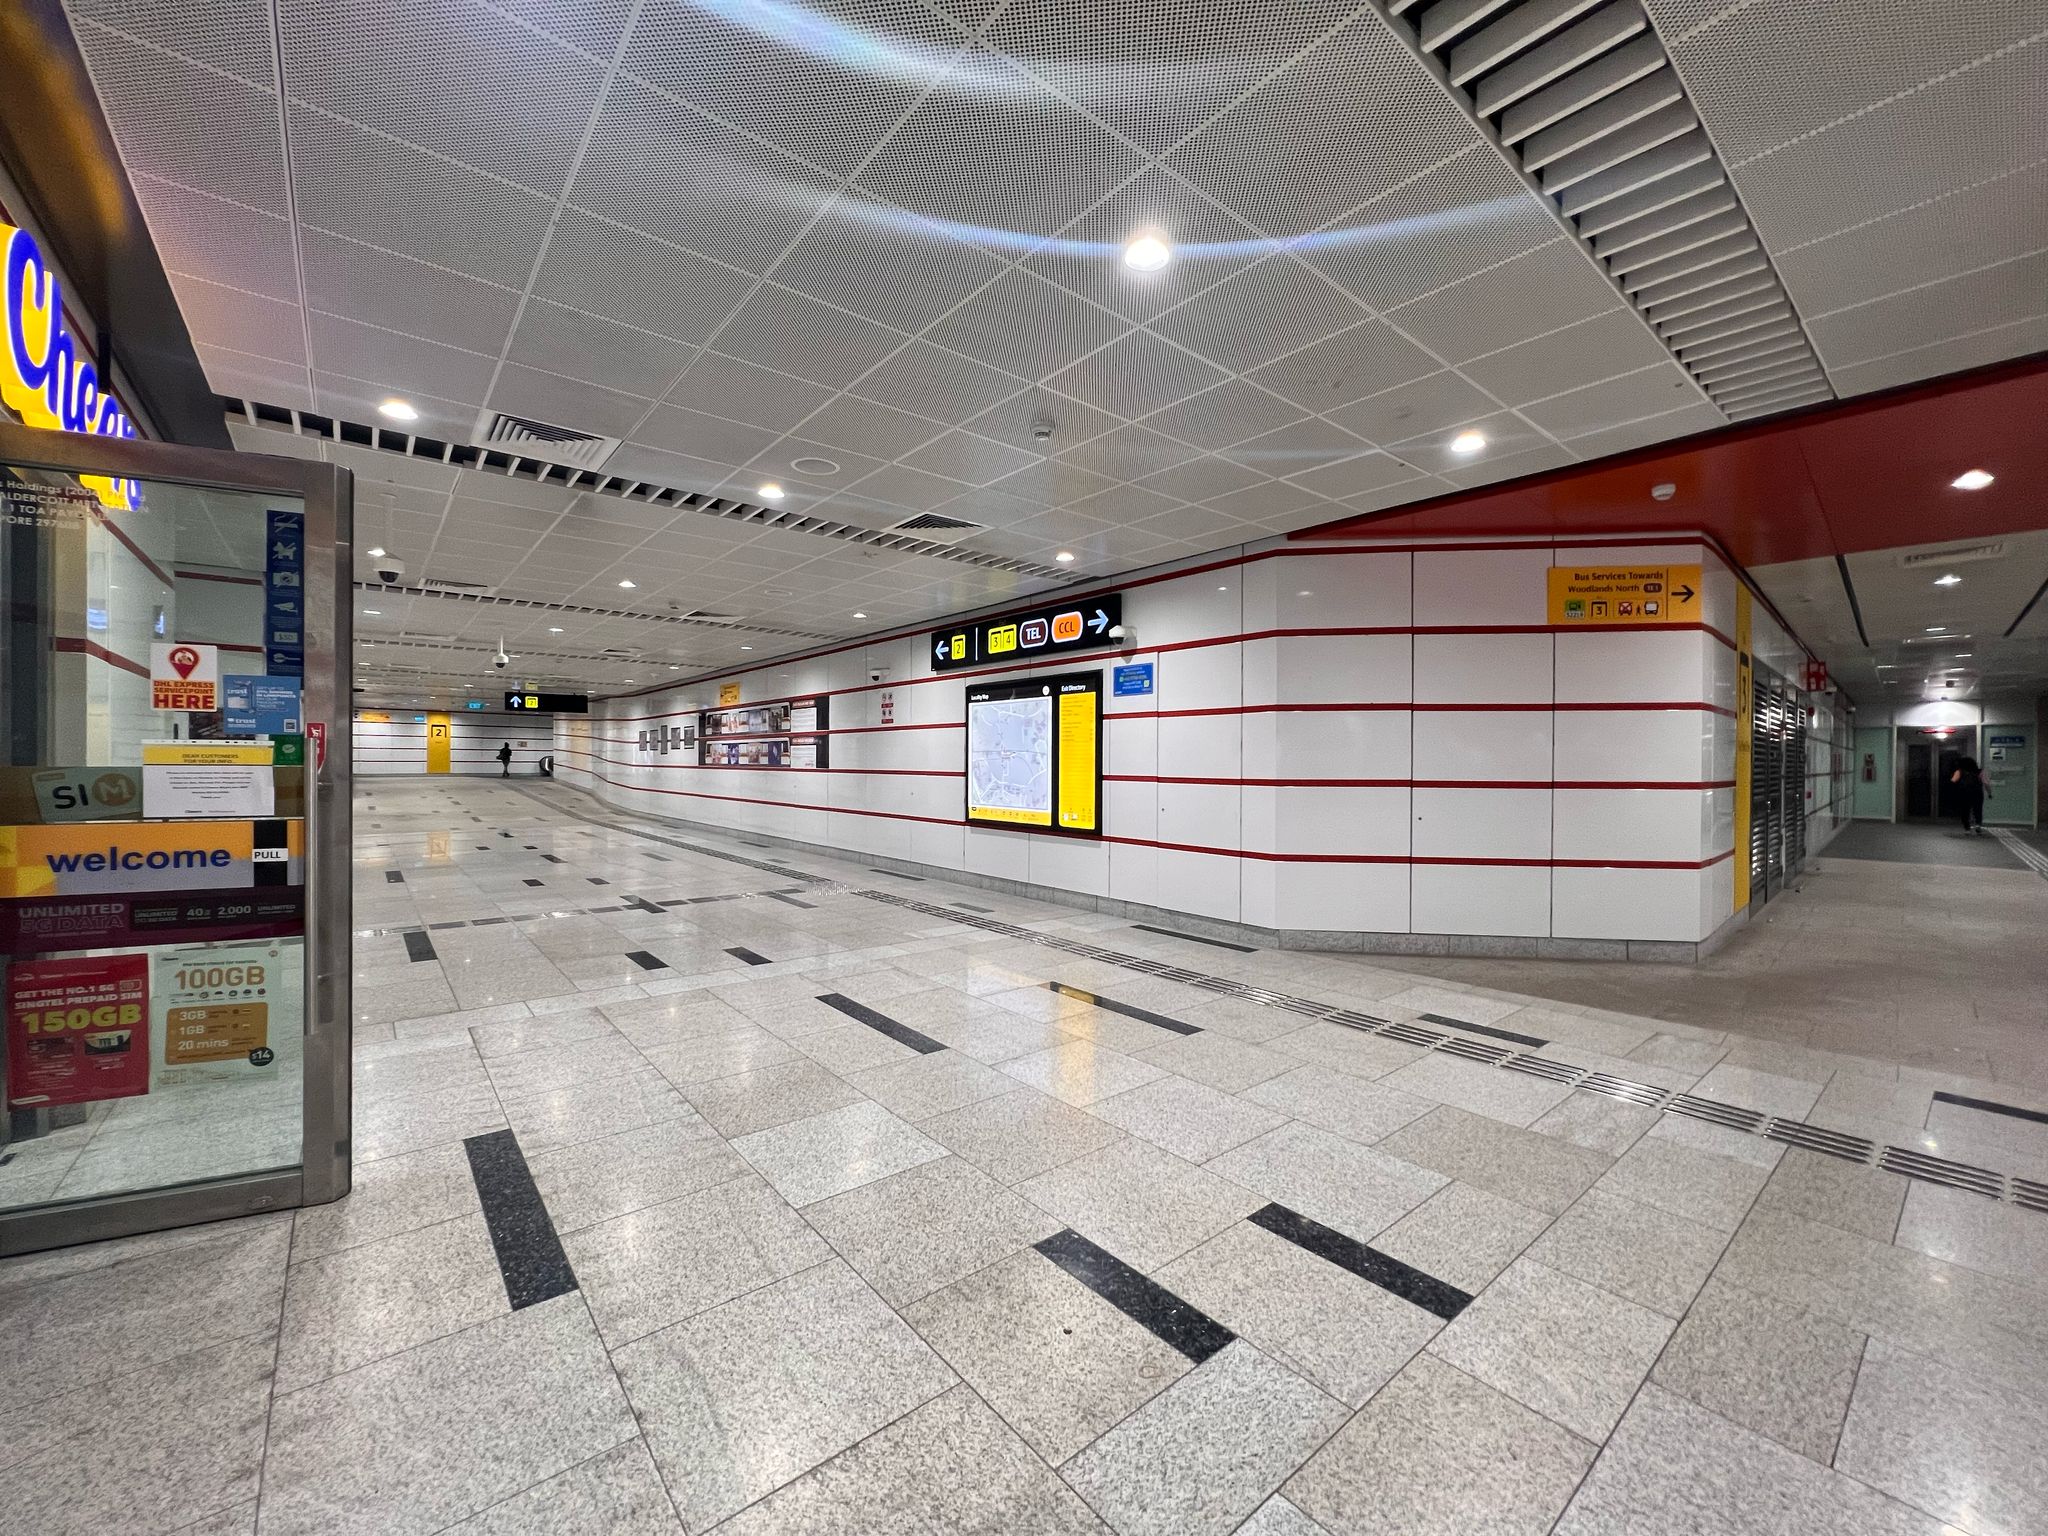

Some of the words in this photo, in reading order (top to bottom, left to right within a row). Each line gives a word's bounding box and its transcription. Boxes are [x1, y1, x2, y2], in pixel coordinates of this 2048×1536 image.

[7, 480, 61, 495] Holdings
[20, 505, 46, 515] TOA
[1574, 573, 1589, 581] Bus
[1592, 572, 1626, 580] Services
[1629, 571, 1663, 580] Towards
[1568, 585, 1613, 593] Woodlands
[1616, 584, 1640, 592] North
[1596, 606, 1603, 615] 3
[993, 636, 999, 648] 3
[1025, 626, 1042, 641] TEL
[1058, 621, 1075, 635] CCL
[956, 643, 961, 655] 2
[153, 680, 172, 688] DHL
[174, 681, 215, 689] EXPRESS
[1068, 684, 1086, 692] Directory
[153, 687, 215, 695] SERVICEPOINT
[153, 694, 215, 709] HERE
[46, 846, 231, 873] welcome
[254, 851, 281, 860] PULL
[20, 903, 125, 918] UNLIMITED
[20, 918, 54, 934] 5G
[57, 915, 124, 930] DATA
[174, 966, 265, 990] 100GB
[14, 990, 40, 999] GET
[41, 988, 63, 997] THE
[14, 998, 65, 1010] SINGTEL
[67, 993, 119, 1005] PREPAID
[120, 992, 143, 1000] SIM
[21, 1003, 143, 1034] 150GB
[180, 1010, 207, 1021] 3GB
[179, 1024, 206, 1036] 1GB
[178, 1040, 194, 1051] 20
[196, 1038, 229, 1049] mins
[251, 1050, 271, 1060] $14
